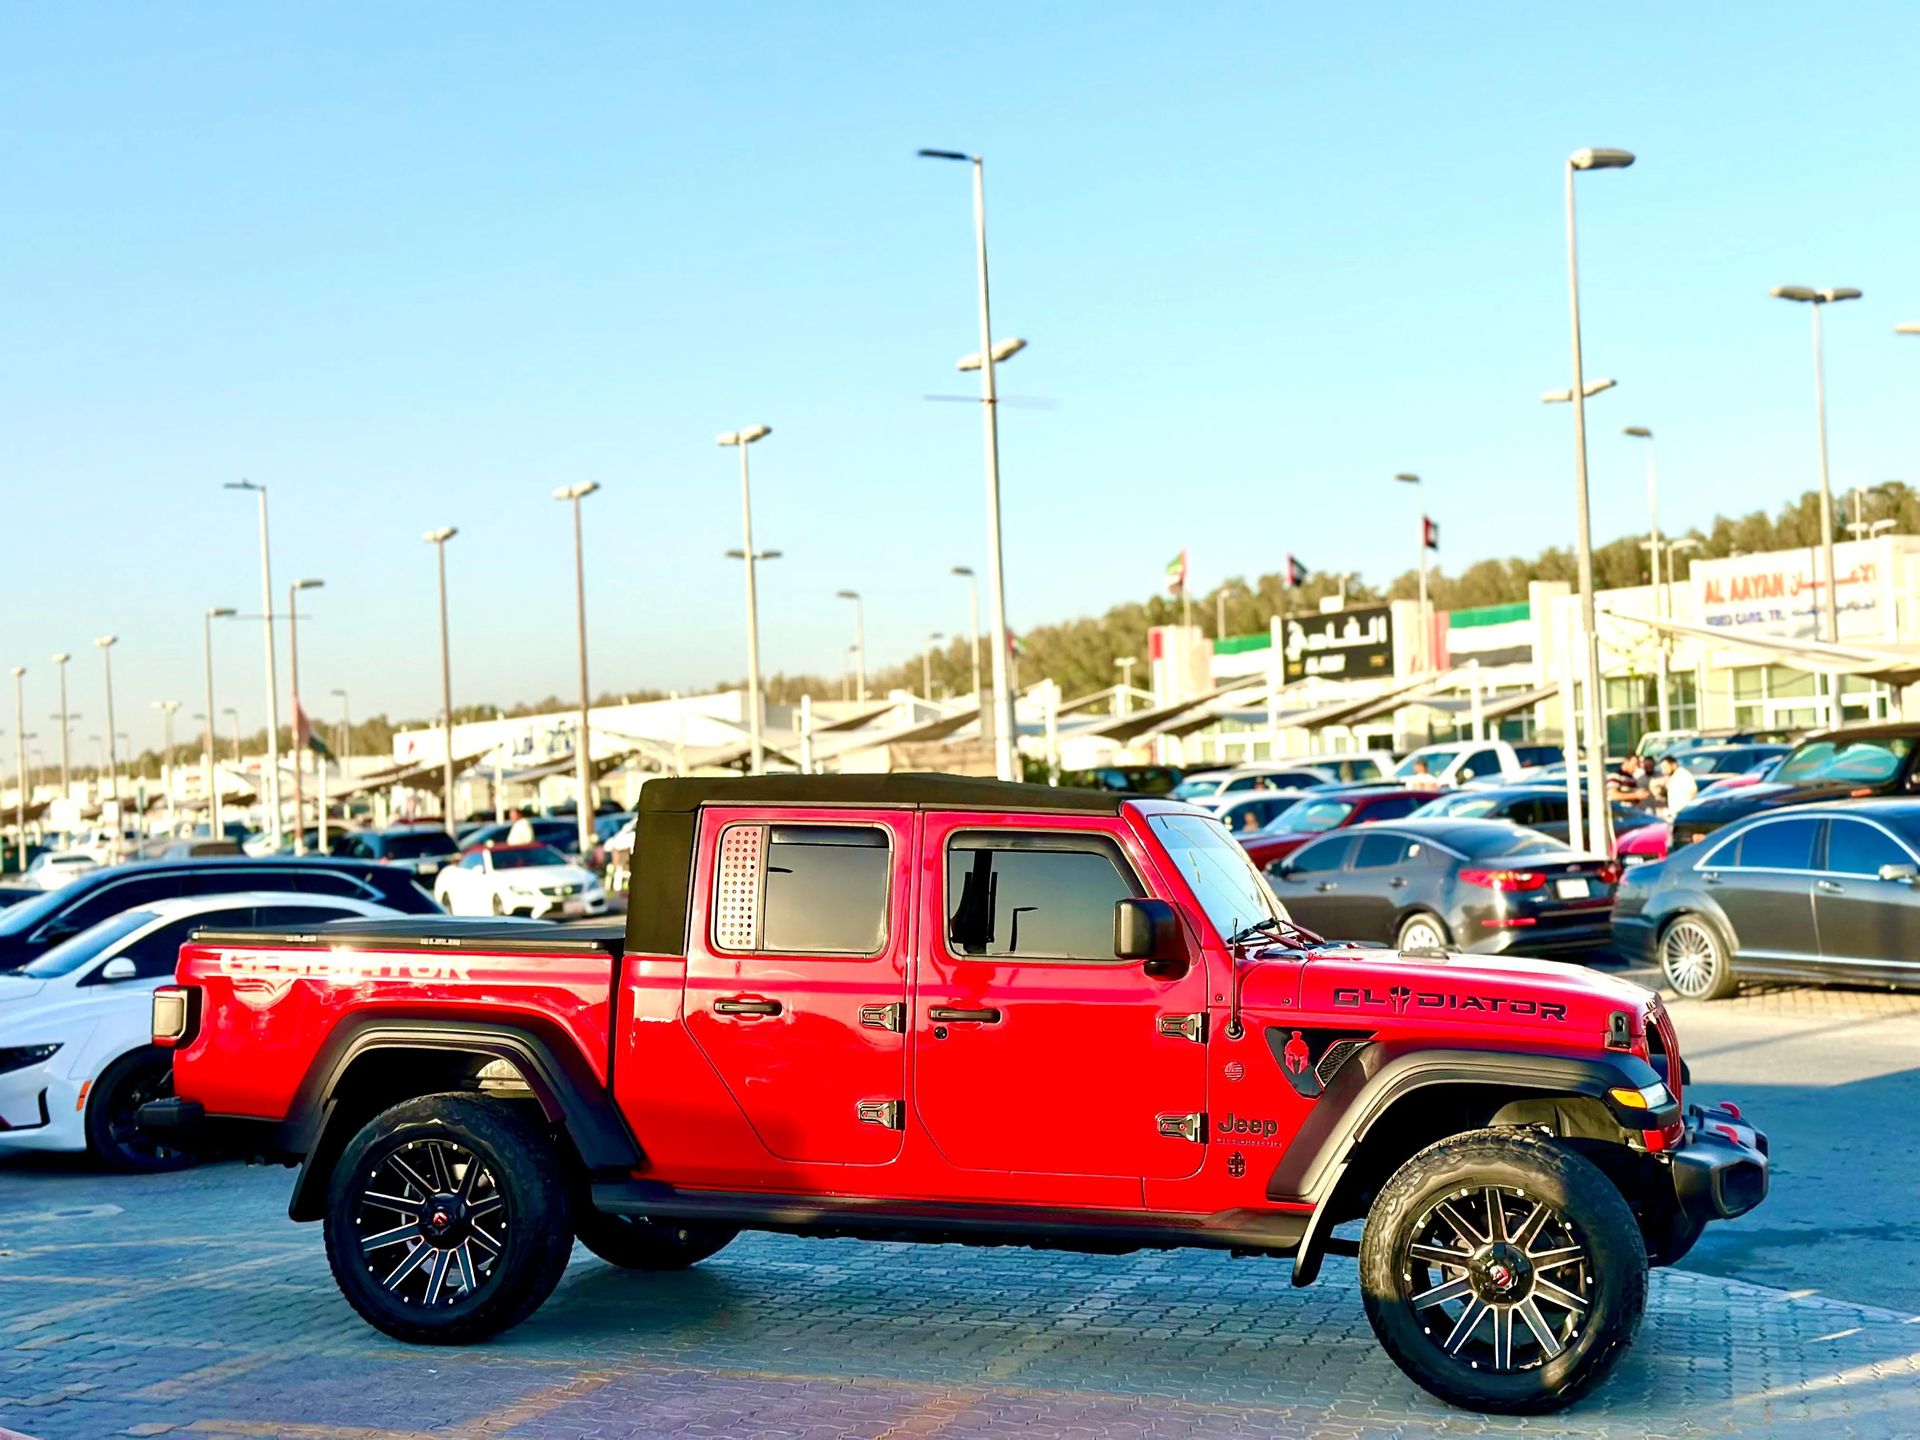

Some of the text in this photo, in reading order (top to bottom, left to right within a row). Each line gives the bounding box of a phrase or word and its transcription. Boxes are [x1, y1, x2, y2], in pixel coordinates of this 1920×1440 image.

[1705, 579, 1725, 604] AL
[1333, 985, 1568, 1022] GLDIATOR
[1218, 1112, 1278, 1139] Jeep
